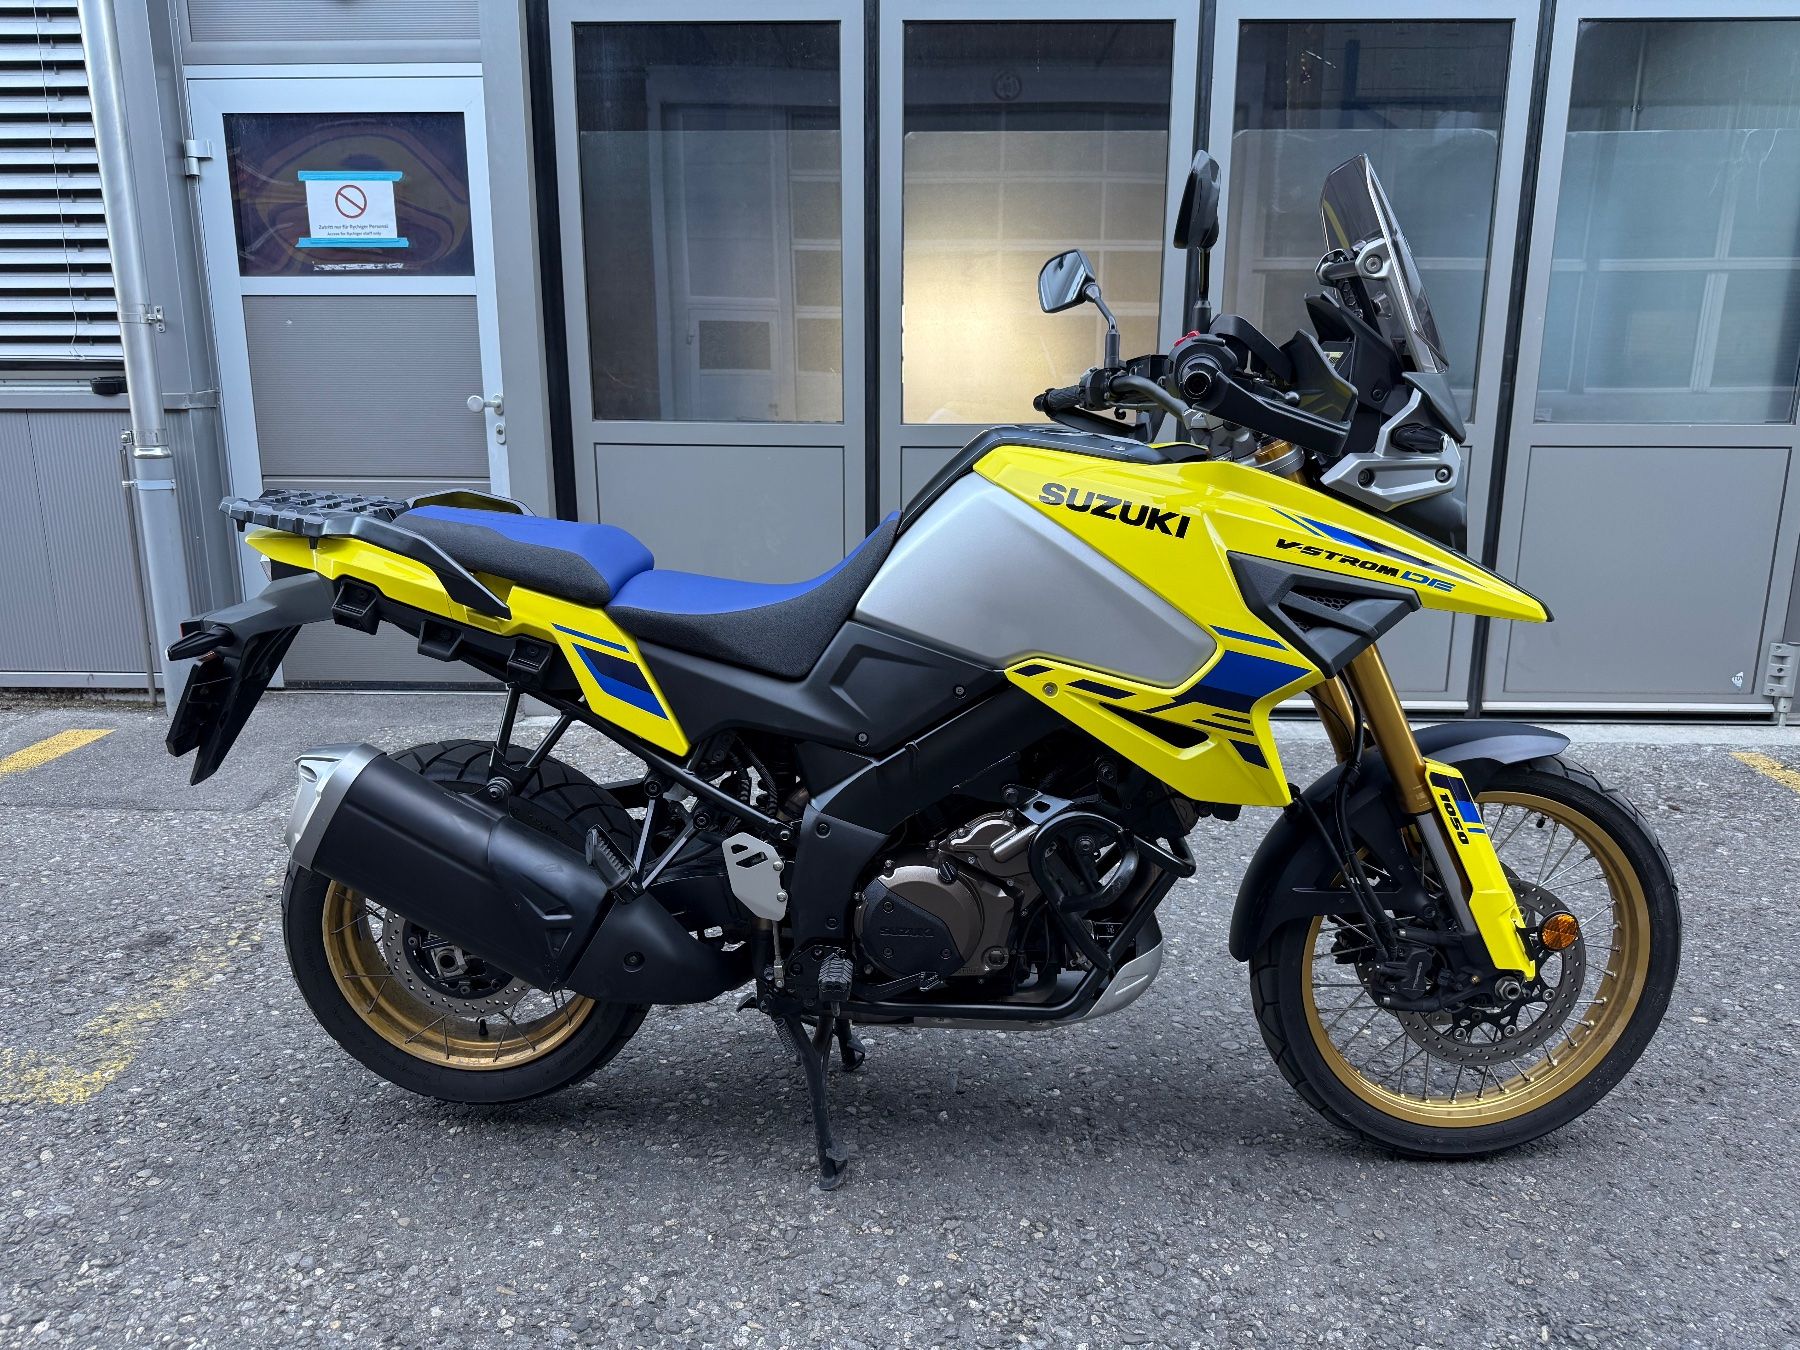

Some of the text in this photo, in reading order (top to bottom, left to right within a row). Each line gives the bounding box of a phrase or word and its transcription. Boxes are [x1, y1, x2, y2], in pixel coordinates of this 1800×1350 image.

[1038, 482, 1191, 539] SUZUKI
[1275, 538, 1457, 593] V-STROM DE
[1439, 792, 1470, 845] 1050
